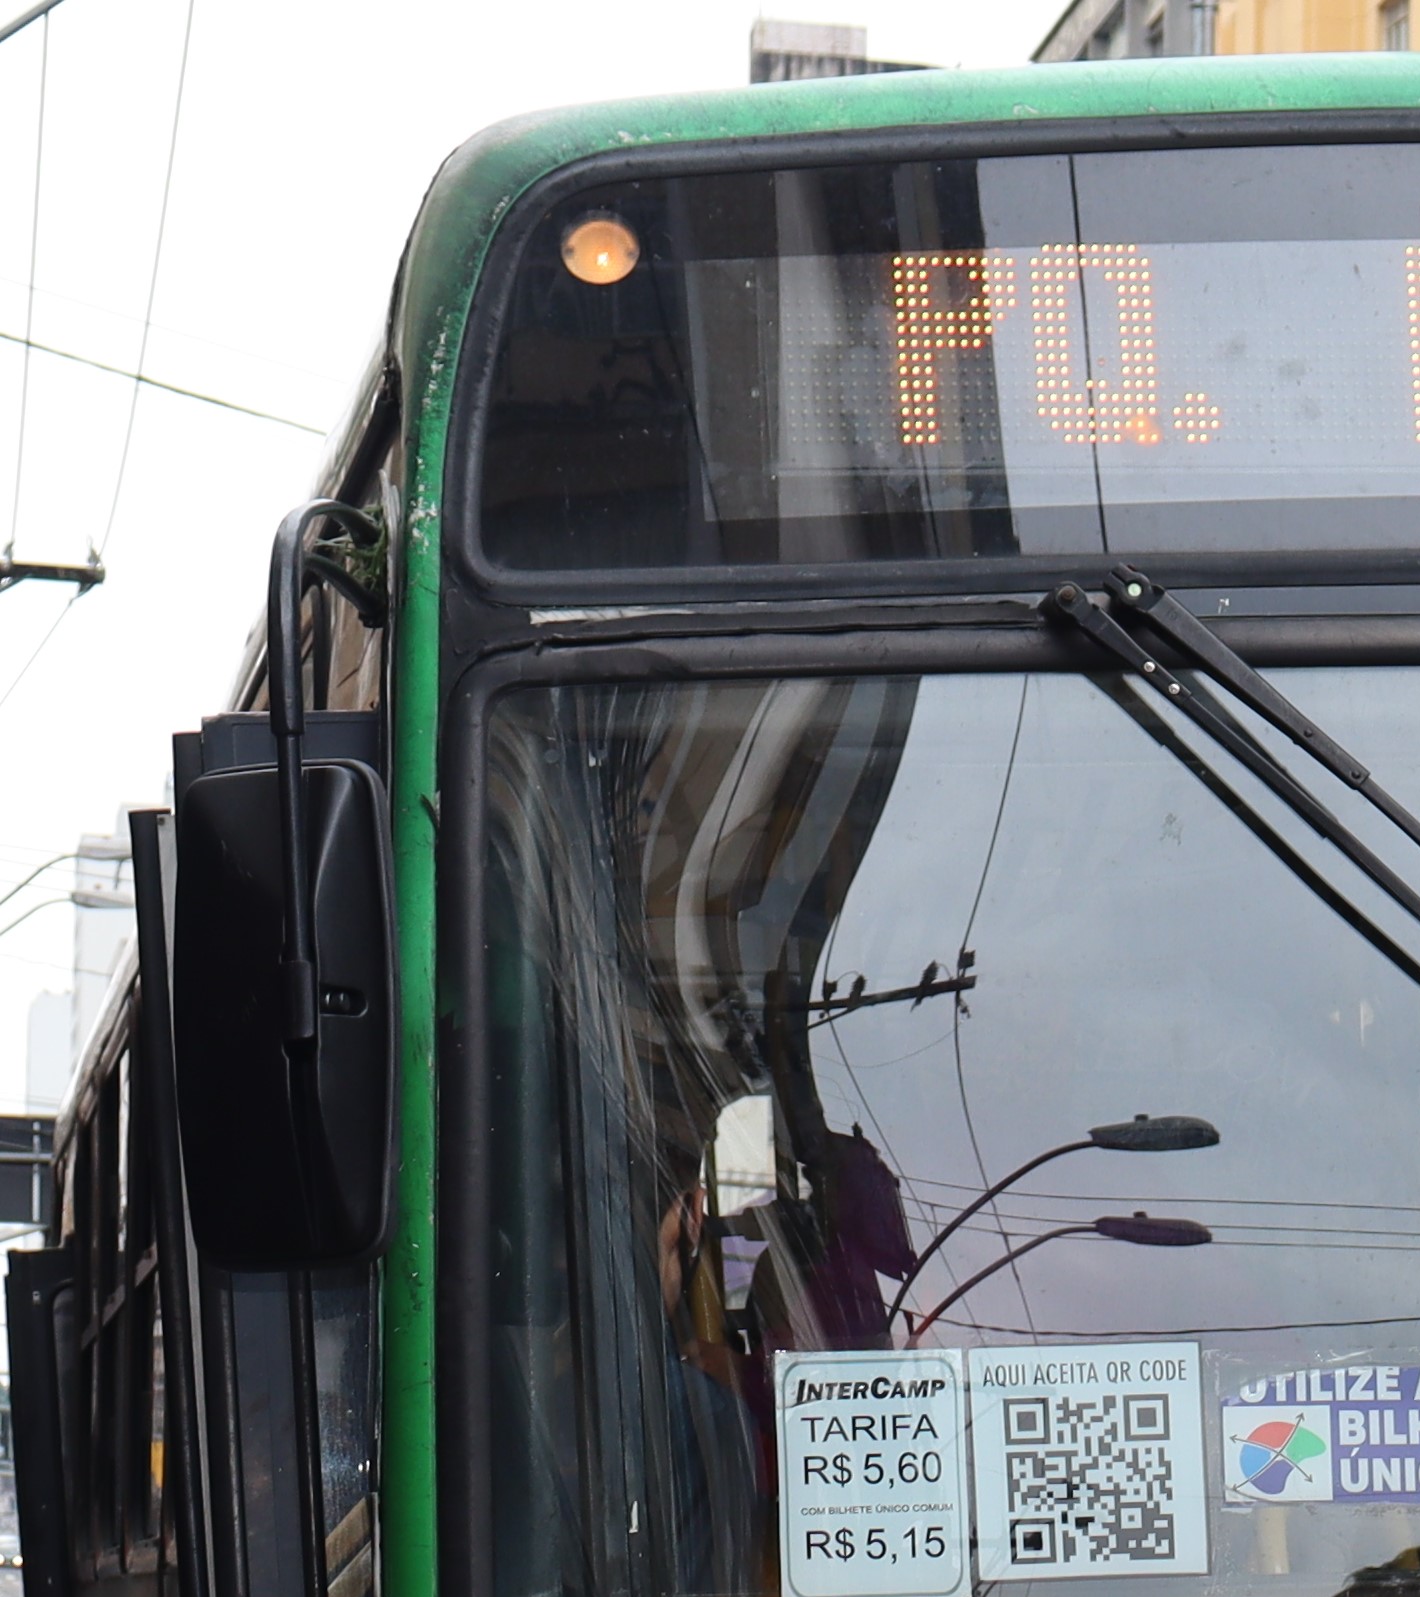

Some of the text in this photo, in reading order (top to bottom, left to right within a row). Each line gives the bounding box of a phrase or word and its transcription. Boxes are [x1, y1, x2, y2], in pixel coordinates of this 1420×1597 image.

[983, 1359, 1188, 1389] AQUI ACEITA QR CODE
[1239, 1366, 1402, 1403] UTILIZE
[801, 1413, 939, 1443] TARIFA
[803, 1450, 942, 1490] R$ 5,60
[800, 1503, 954, 1516] COM BILHETE ÚNICO COMUM
[805, 1525, 946, 1563] R$ 5,15
